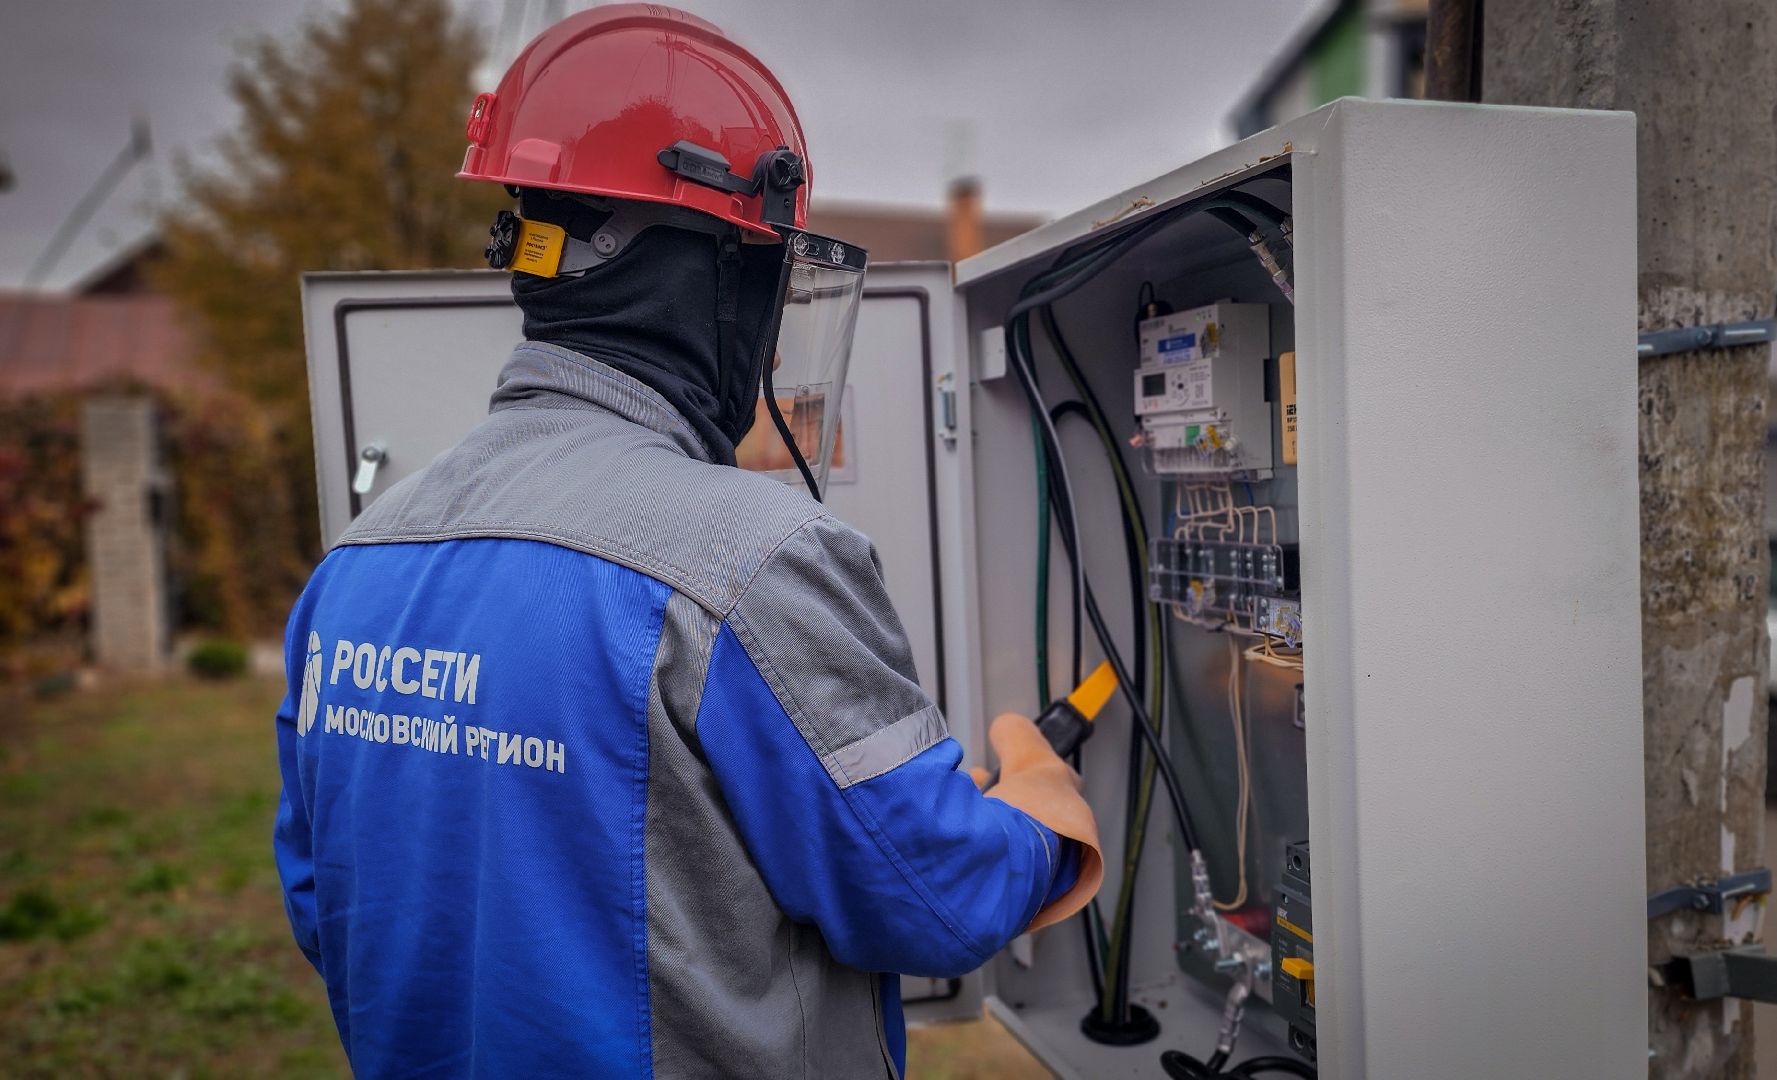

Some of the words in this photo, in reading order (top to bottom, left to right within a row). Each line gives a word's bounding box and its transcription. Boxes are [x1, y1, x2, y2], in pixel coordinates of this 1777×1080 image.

[330, 640, 480, 704] РОССЕТИ
[325, 704, 459, 754] МОСКОВСКИЙ
[465, 725, 565, 774] РЕГИОН
